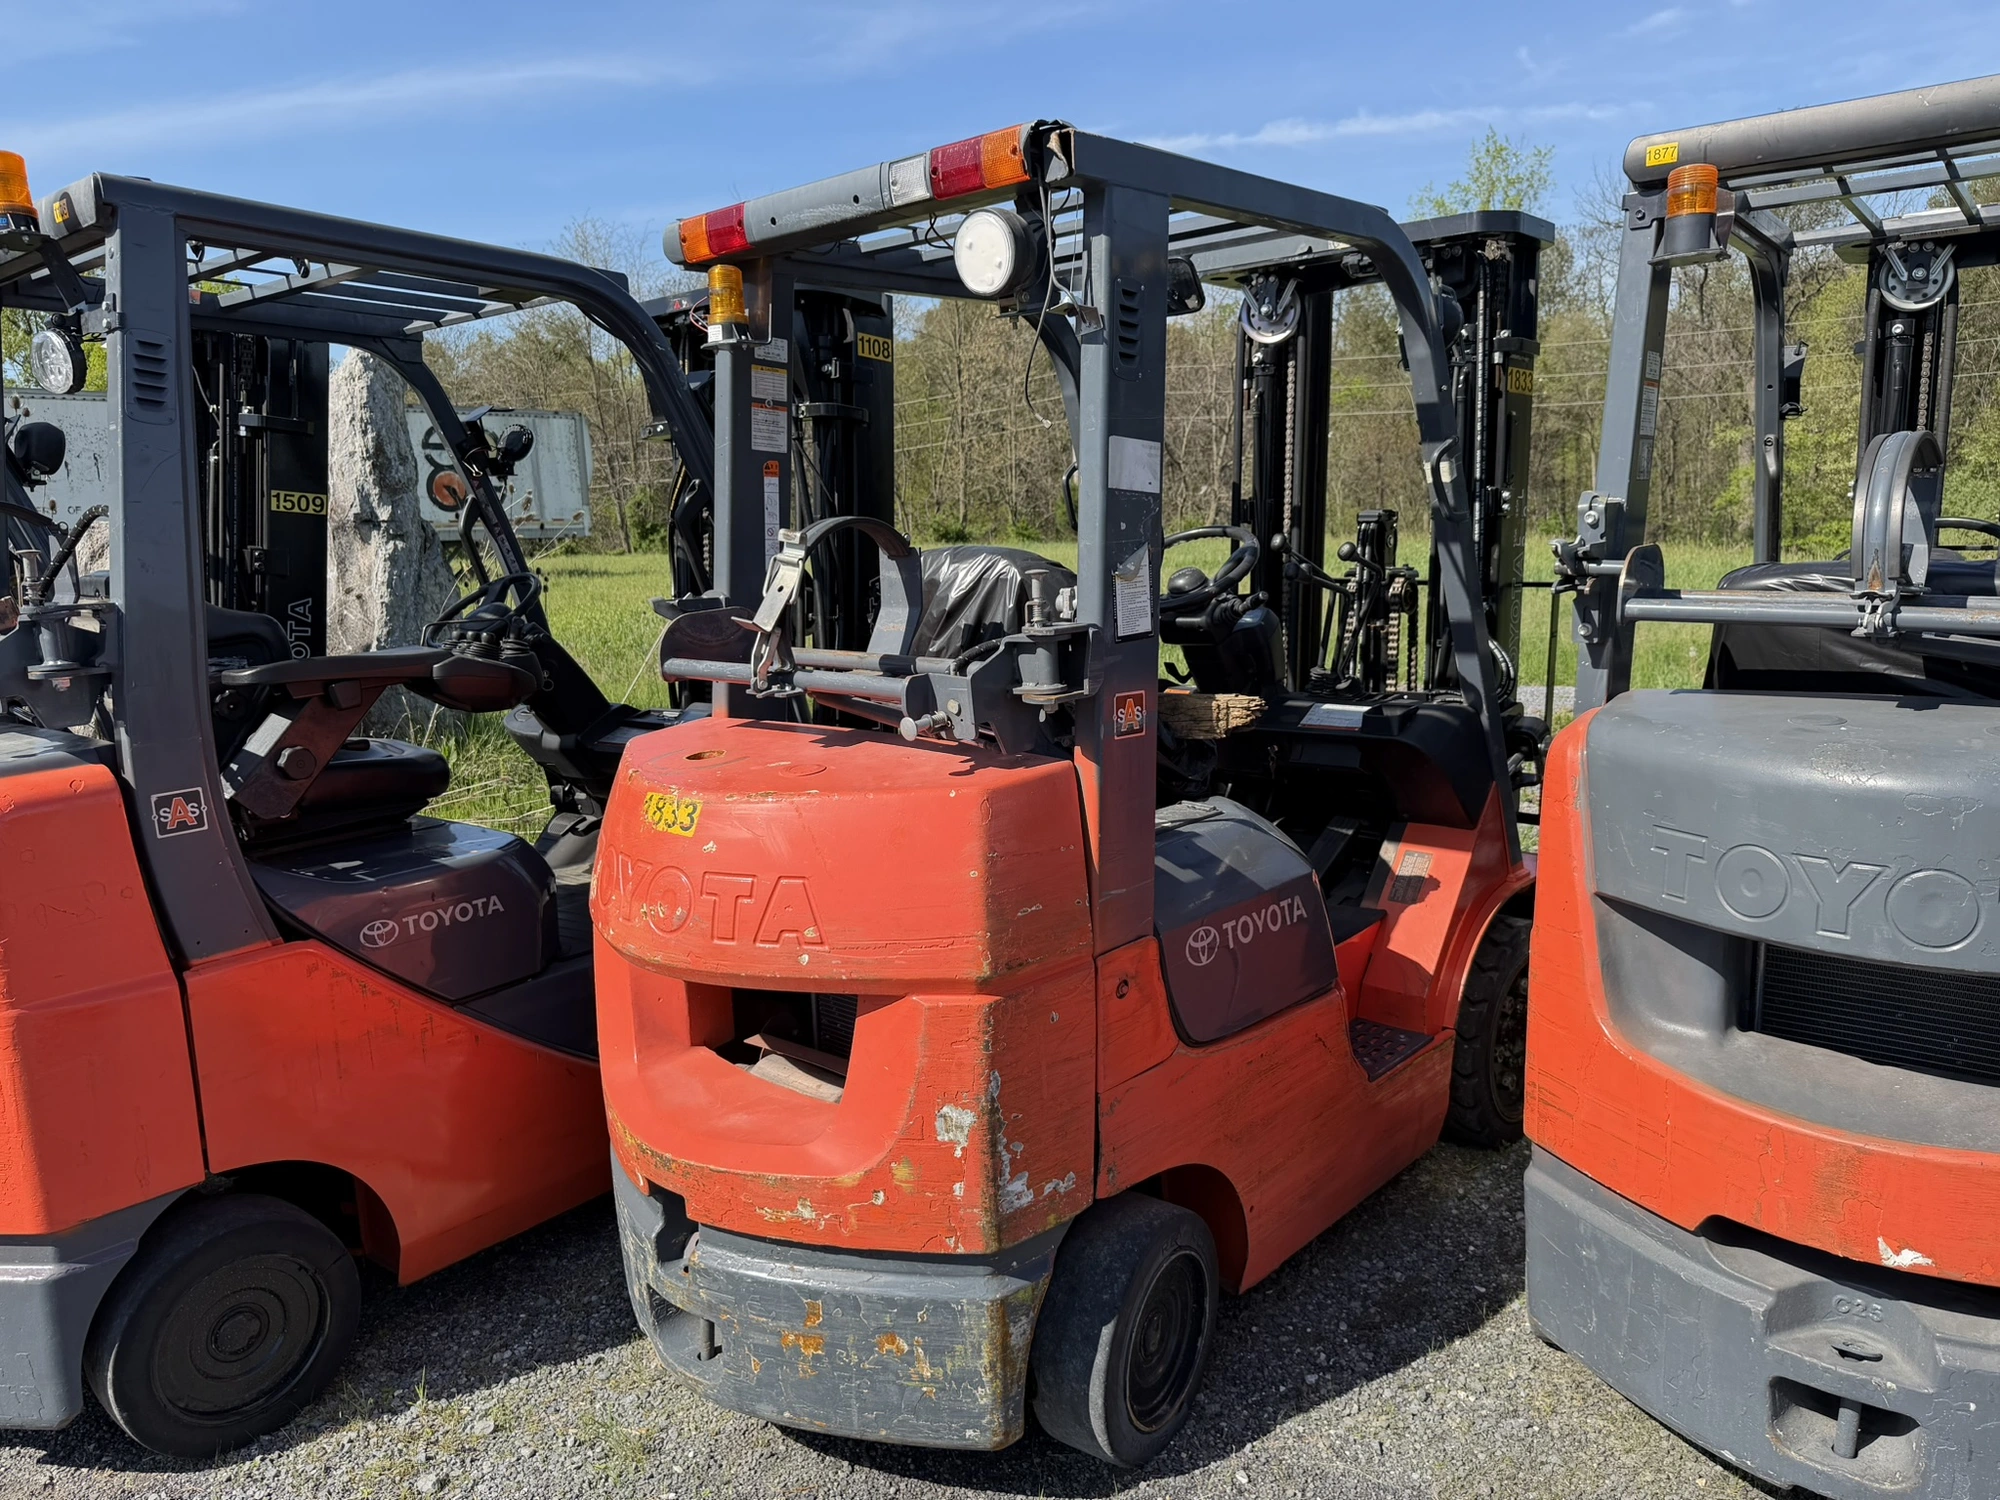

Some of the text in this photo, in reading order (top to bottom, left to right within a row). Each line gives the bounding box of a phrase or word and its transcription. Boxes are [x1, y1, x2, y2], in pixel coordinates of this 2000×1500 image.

[1647, 145, 1678, 162] 1877
[859, 336, 891, 359] 1108
[1508, 368, 1534, 392] 1833
[67, 505, 81, 515] OF
[272, 492, 325, 514] 1509
[288, 597, 313, 660] OTA
[1117, 698, 1143, 732] SAS
[159, 796, 200, 830] SAS
[596, 838, 829, 953] OYOTA
[1650, 824, 1987, 953] TOYO
[402, 894, 505, 936] TOYOTA
[1222, 894, 1308, 950] TOYOTA
